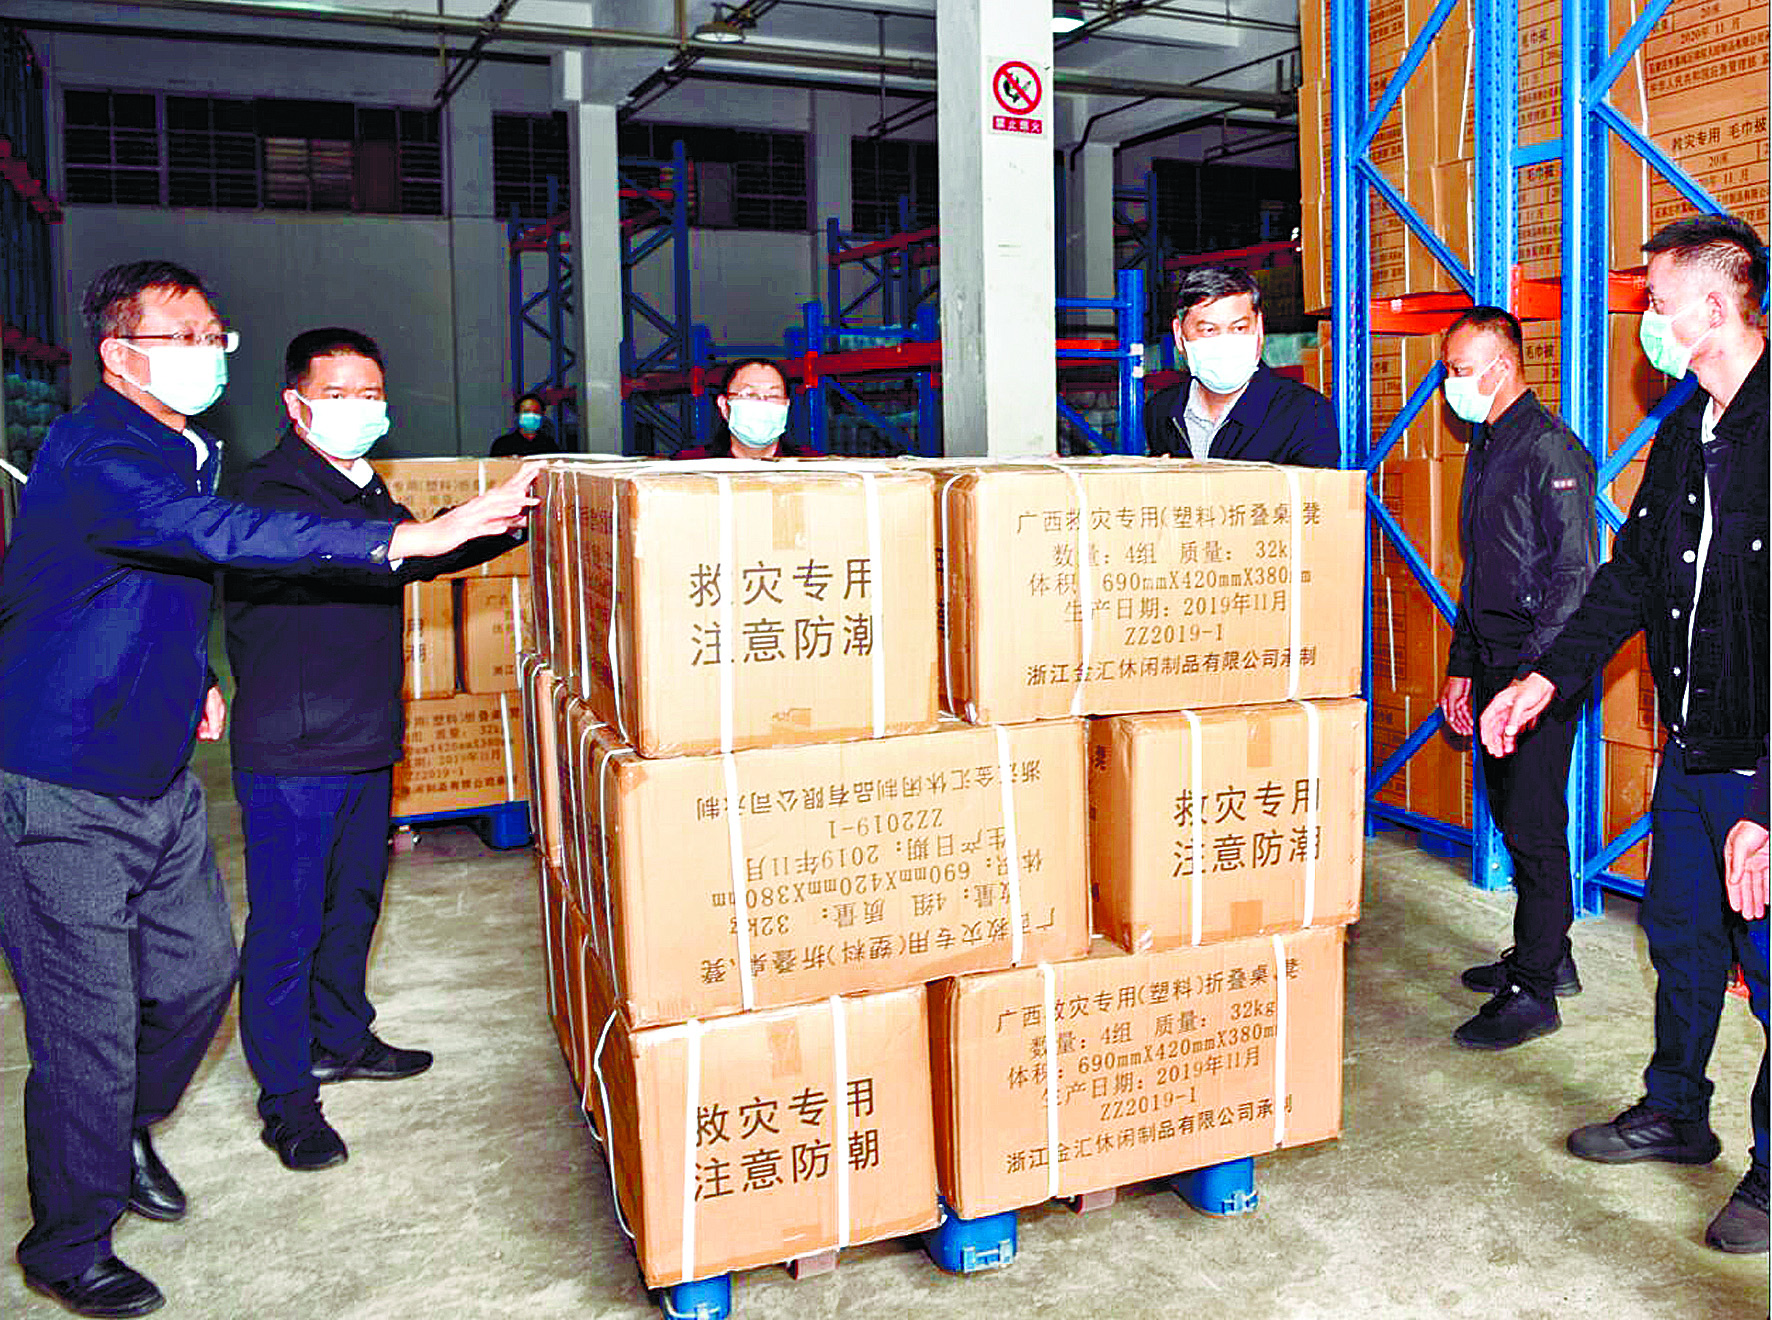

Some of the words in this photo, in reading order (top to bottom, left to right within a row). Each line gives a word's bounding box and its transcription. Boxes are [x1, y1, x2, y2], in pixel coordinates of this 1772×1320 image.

[1255, 539, 1290, 559] 32k
[690, 558, 872, 607] 救灾专用
[691, 613, 874, 666] 注意防潮
[1124, 623, 1224, 646] ZZ2019-1
[1173, 777, 1320, 828] 救灾专用
[1172, 825, 1322, 878] 注意防潮
[1007, 1023, 1278, 1090] 体积：690mmX420mmX380m
[696, 1077, 874, 1148] 救灾专用
[695, 1128, 880, 1203] 注意防潮
